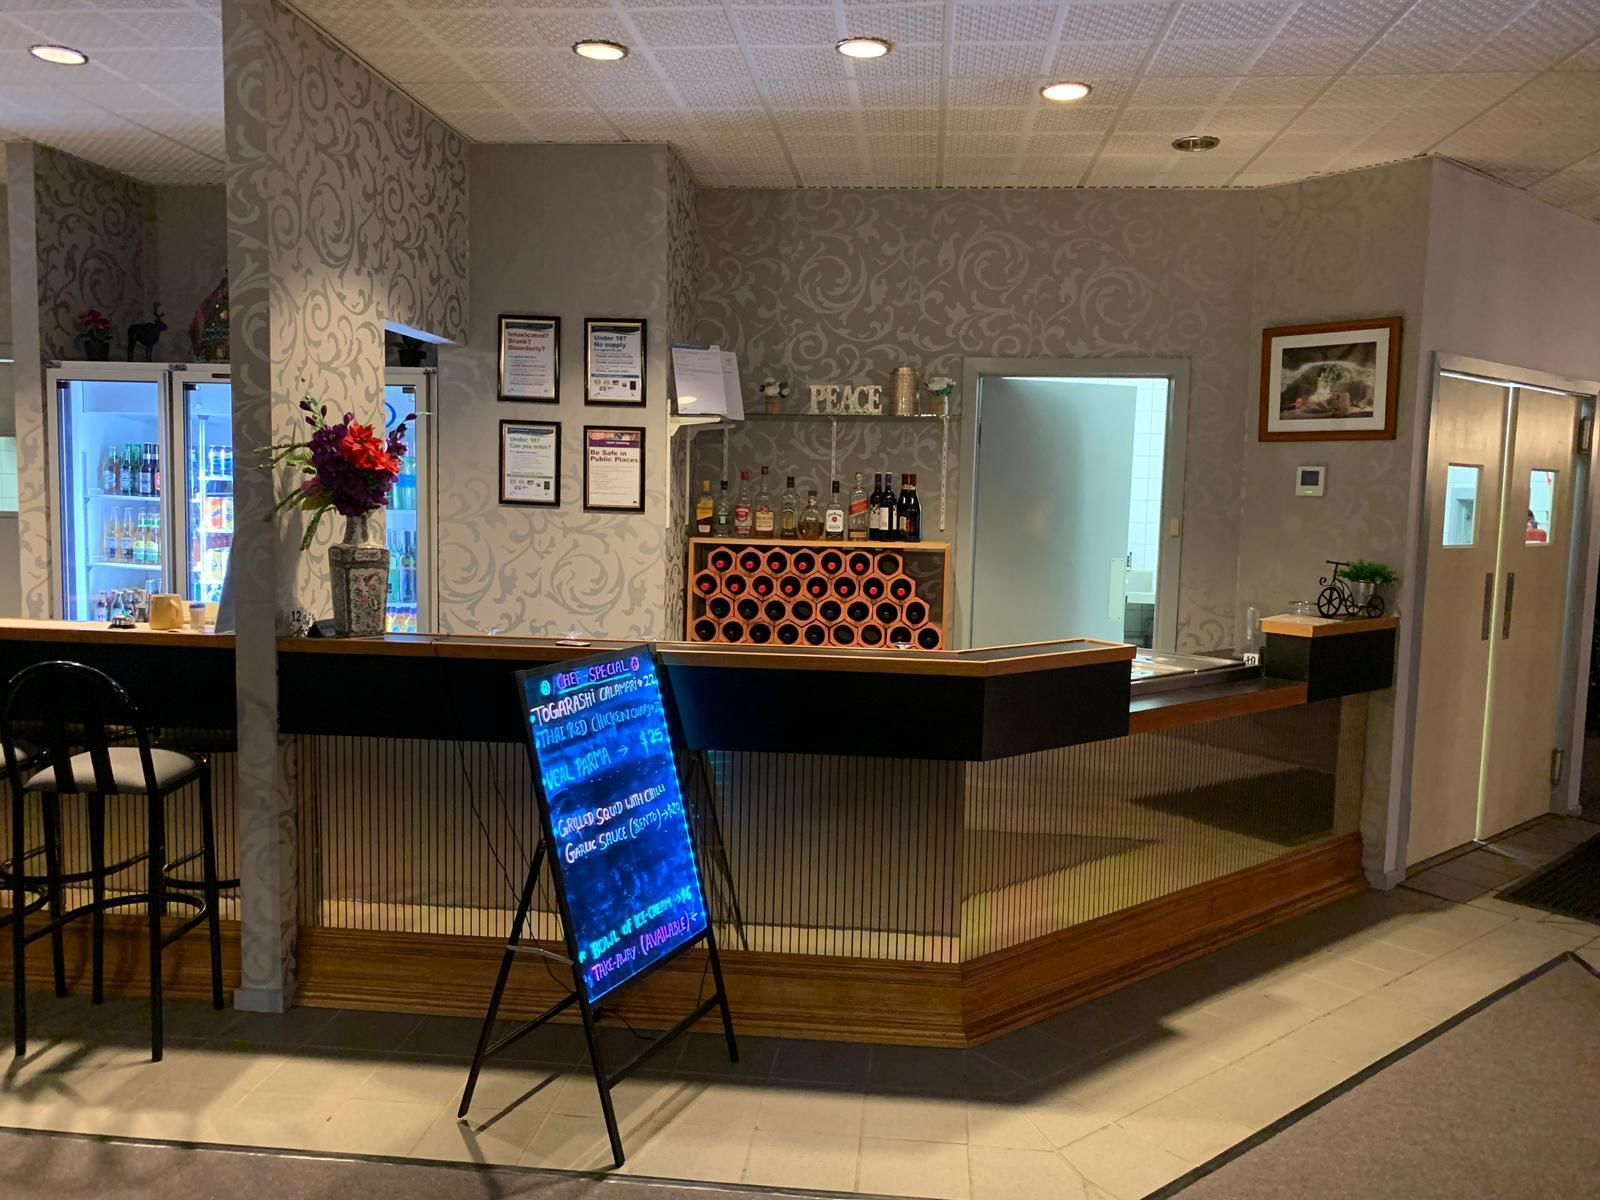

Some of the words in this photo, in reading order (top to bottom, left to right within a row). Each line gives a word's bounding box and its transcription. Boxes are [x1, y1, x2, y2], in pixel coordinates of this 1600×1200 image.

[507, 331, 549, 339] Intoxicated?
[808, 384, 883, 416] PEACE
[291, 610, 302, 622] 12
[589, 660, 629, 682] SPECIAL
[536, 725, 567, 749] THAI
[566, 719, 588, 739] RED
[591, 711, 629, 732] CHICKEN
[575, 747, 612, 778] PARMA
[557, 811, 594, 838] GRILLED
[596, 800, 623, 826] SQUID
[624, 793, 645, 810] WITH
[599, 826, 628, 851] SAUCE
